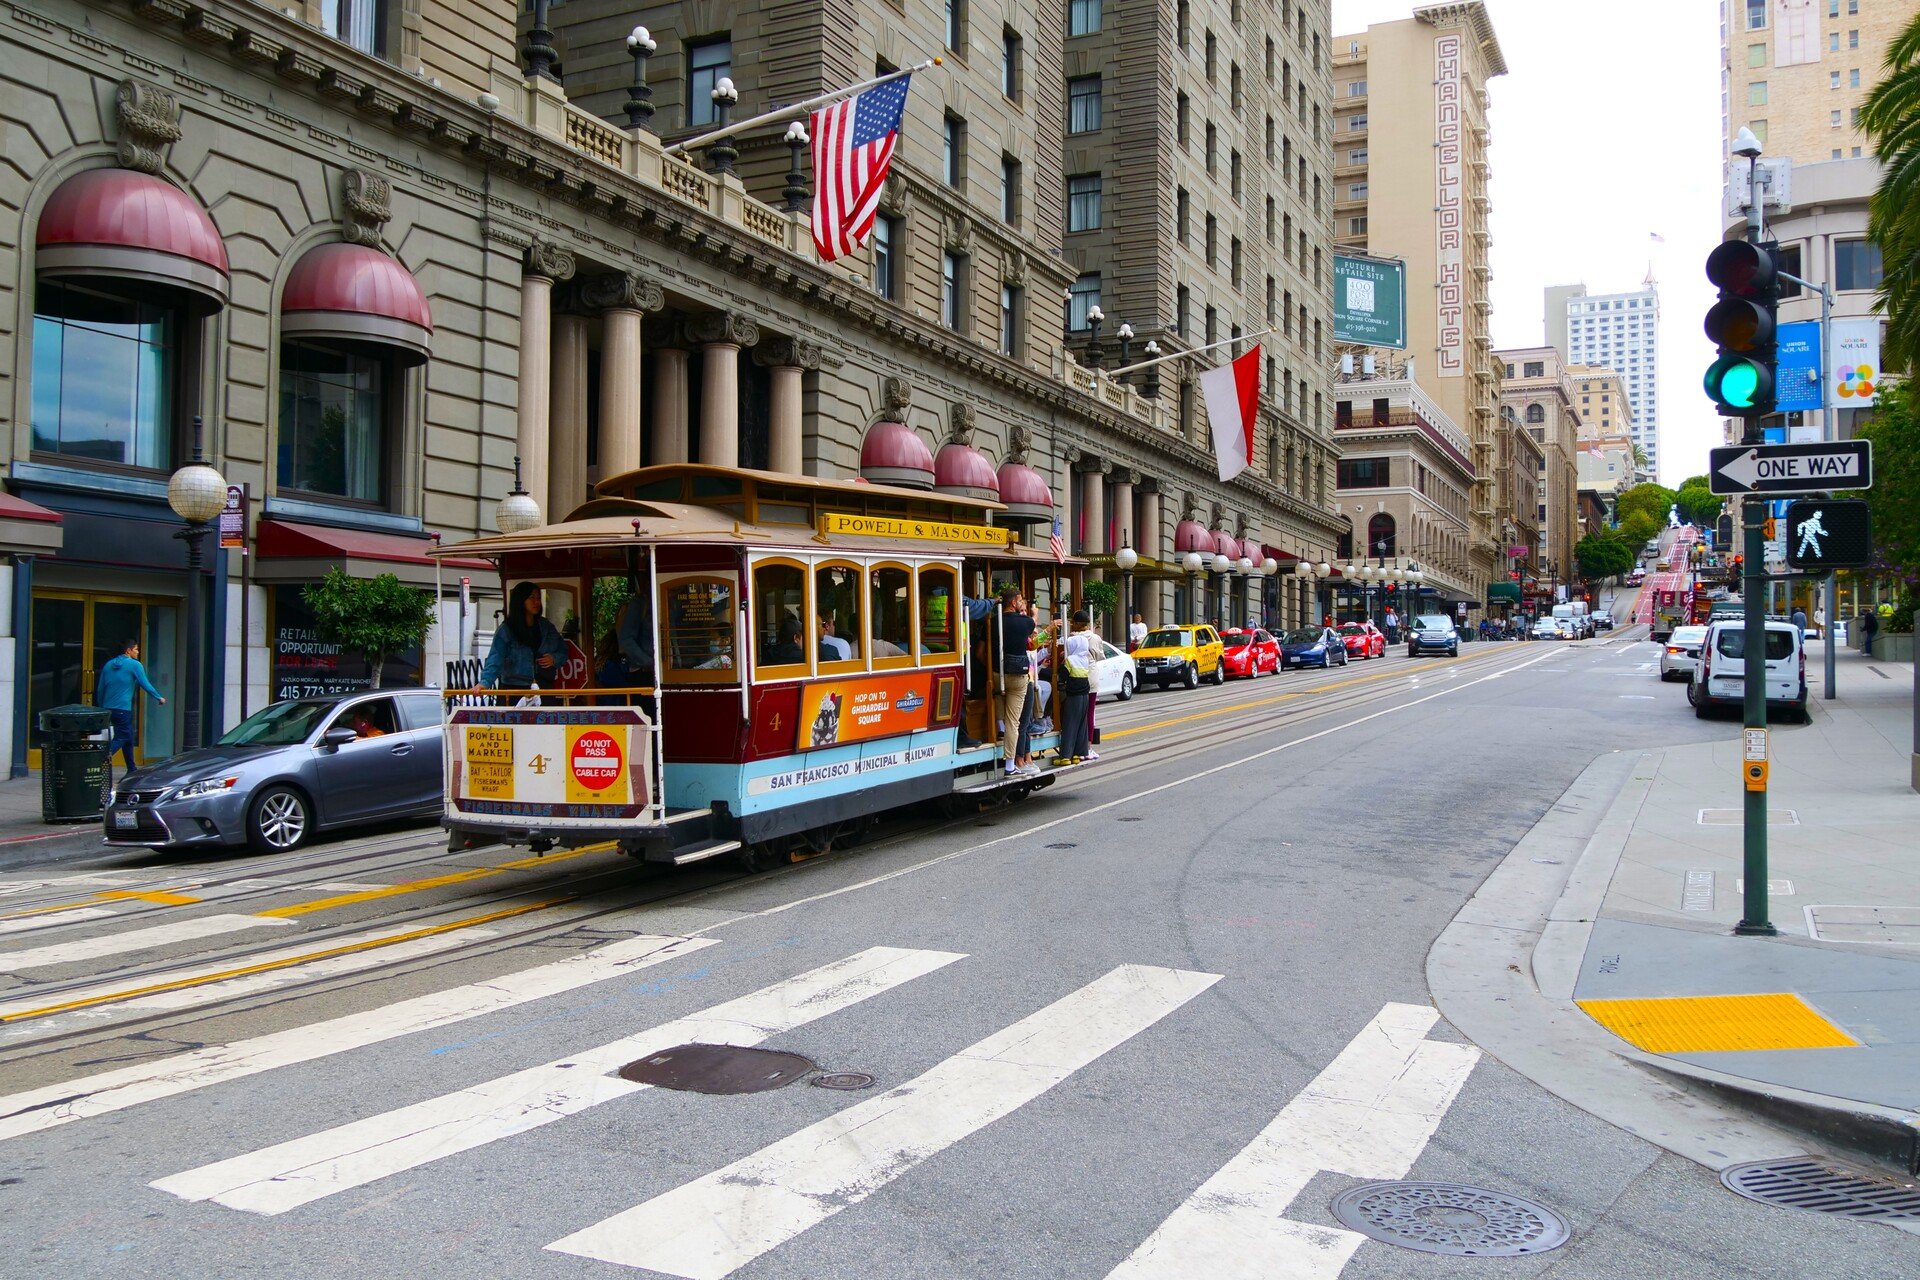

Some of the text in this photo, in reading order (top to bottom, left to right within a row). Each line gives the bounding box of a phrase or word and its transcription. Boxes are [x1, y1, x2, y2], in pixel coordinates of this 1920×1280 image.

[1437, 38, 1461, 369] CHANCELLOR HOTEL
[1345, 261, 1375, 272] FUTURE
[1367, 272, 1384, 281] SITE
[1757, 456, 1852, 478] ONE WAY
[838, 518, 1003, 542] POWELL & MASON Sts.
[1664, 594, 1671, 603] E
[280, 685, 300, 699] 415
[855, 691, 887, 703] HOP ON TO
[851, 702, 889, 715] GHIRARDELLI
[468, 712, 523, 725] MARKET
[536, 712, 601, 725] STREET
[769, 712, 782, 731] 4
[858, 714, 881, 725] SQUARE
[469, 732, 509, 741] POWELL
[580, 739, 611, 748] DO NOT
[468, 748, 510, 757] MARKET
[585, 748, 606, 756] PASS
[528, 753, 547, 775] 4
[770, 746, 936, 789] SAN FRANCISCO MUNICIPAL RAILWAY
[471, 766, 481, 776] BAY
[490, 767, 512, 777] TAYLOR
[576, 769, 617, 777] CABLE CAR
[482, 785, 500, 793] WHARF
[568, 805, 627, 818] WHARF
